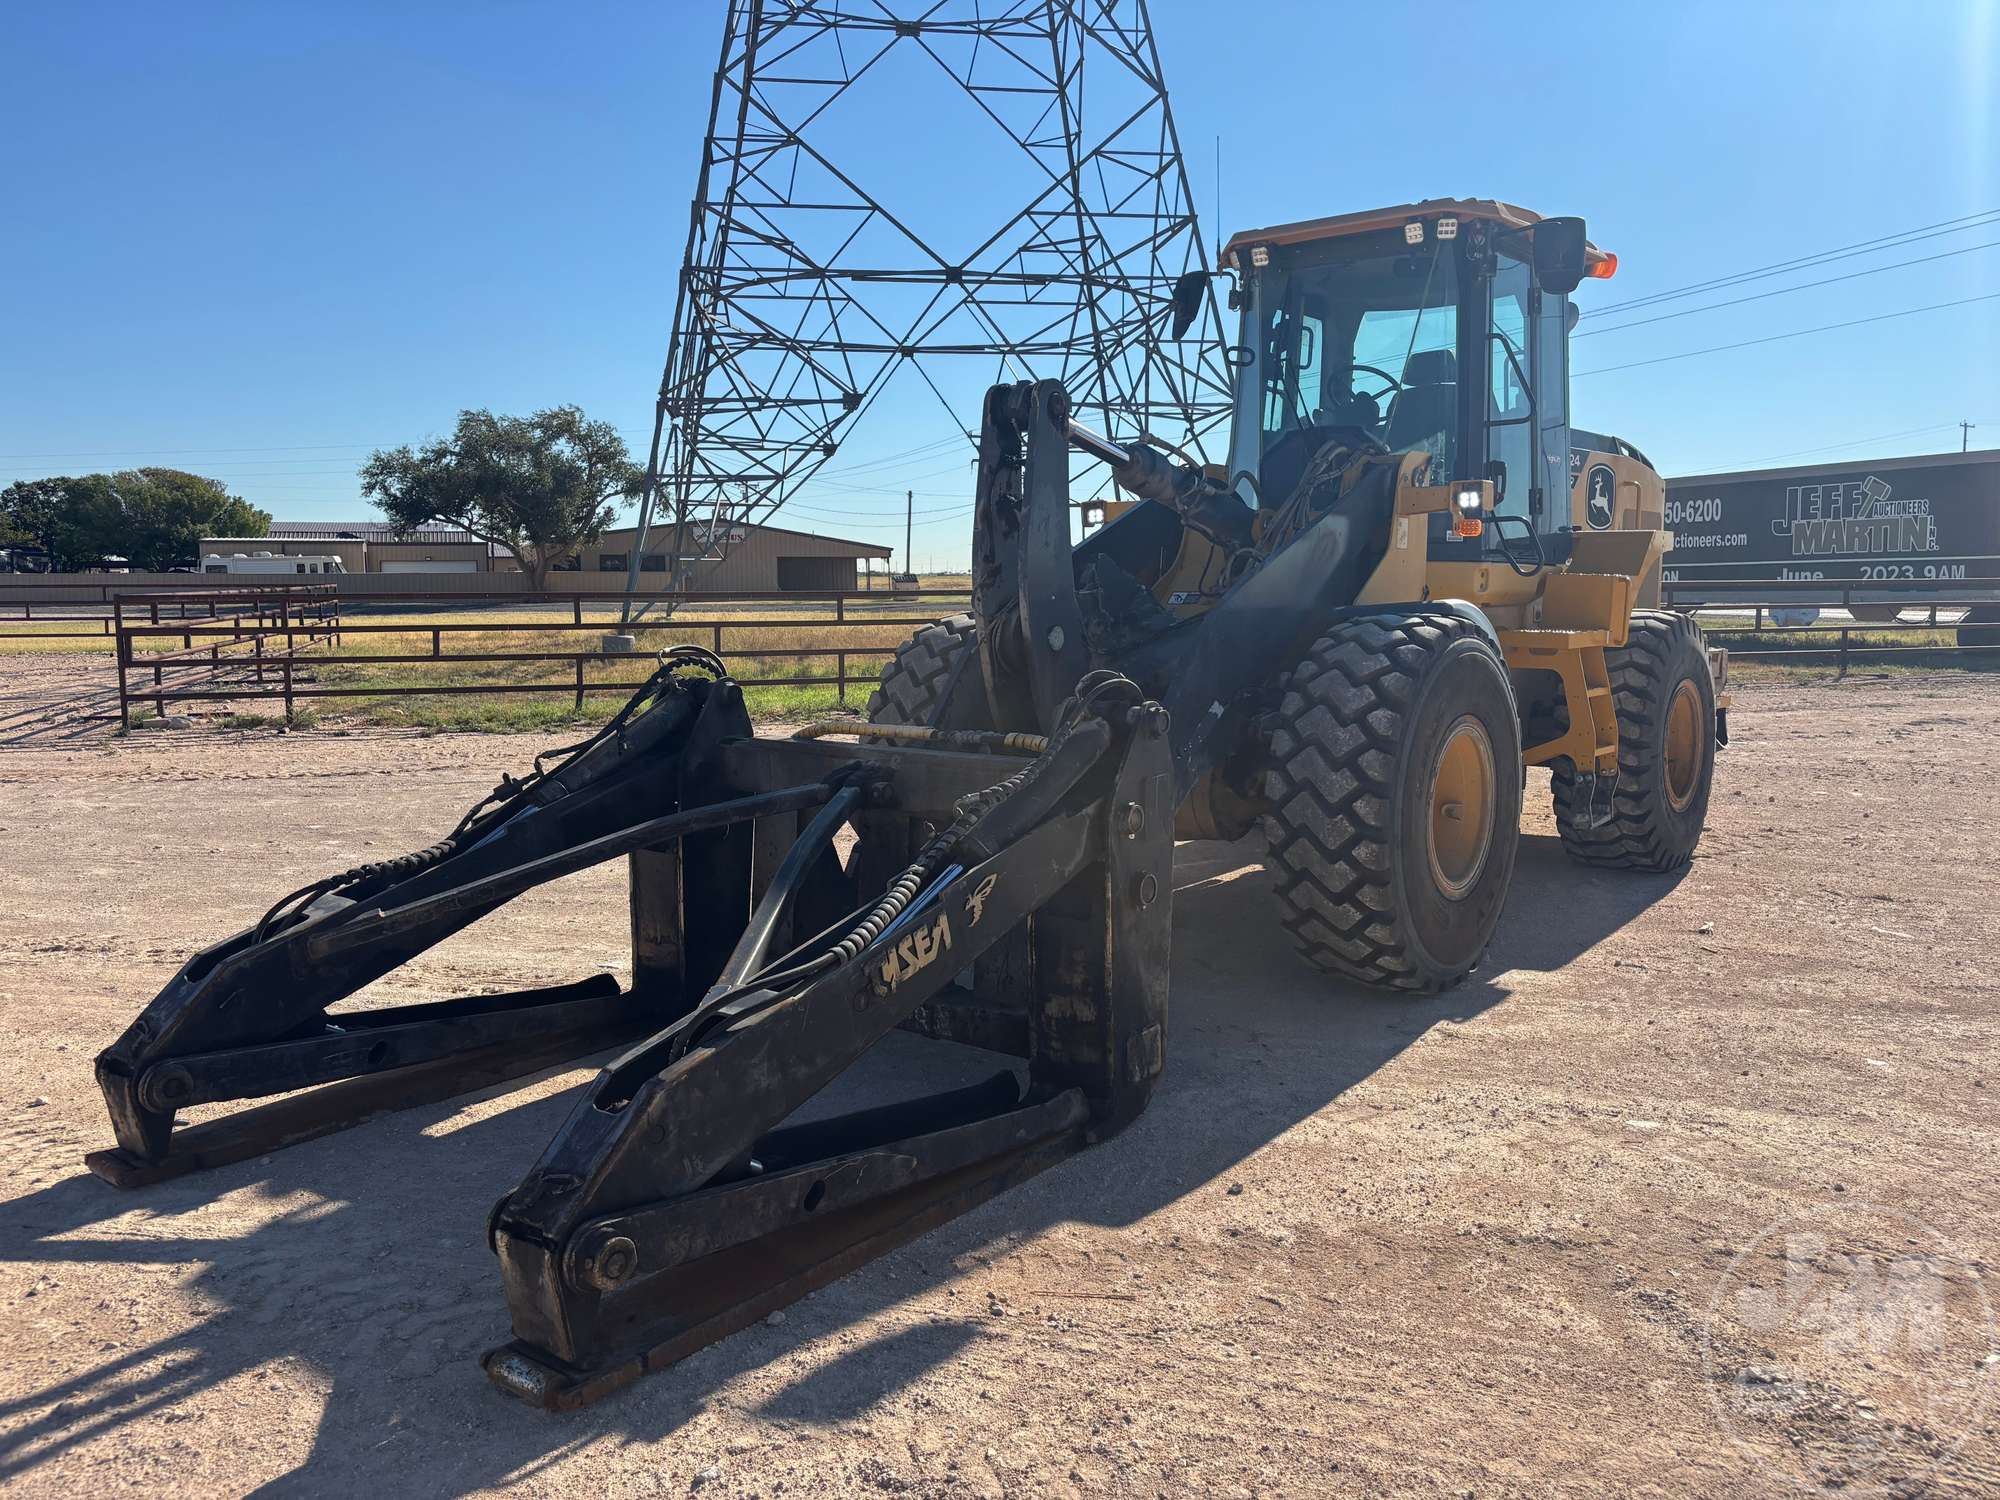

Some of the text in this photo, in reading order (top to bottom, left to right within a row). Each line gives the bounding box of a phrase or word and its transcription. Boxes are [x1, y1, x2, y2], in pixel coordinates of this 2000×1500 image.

[1772, 482, 1863, 536] JEFF
[1872, 499, 1929, 517] AUCTIONEERS
[1792, 515, 1929, 555] MARTIN
[1860, 565, 1915, 580] 2023
[1923, 564, 1966, 580] 9AM
